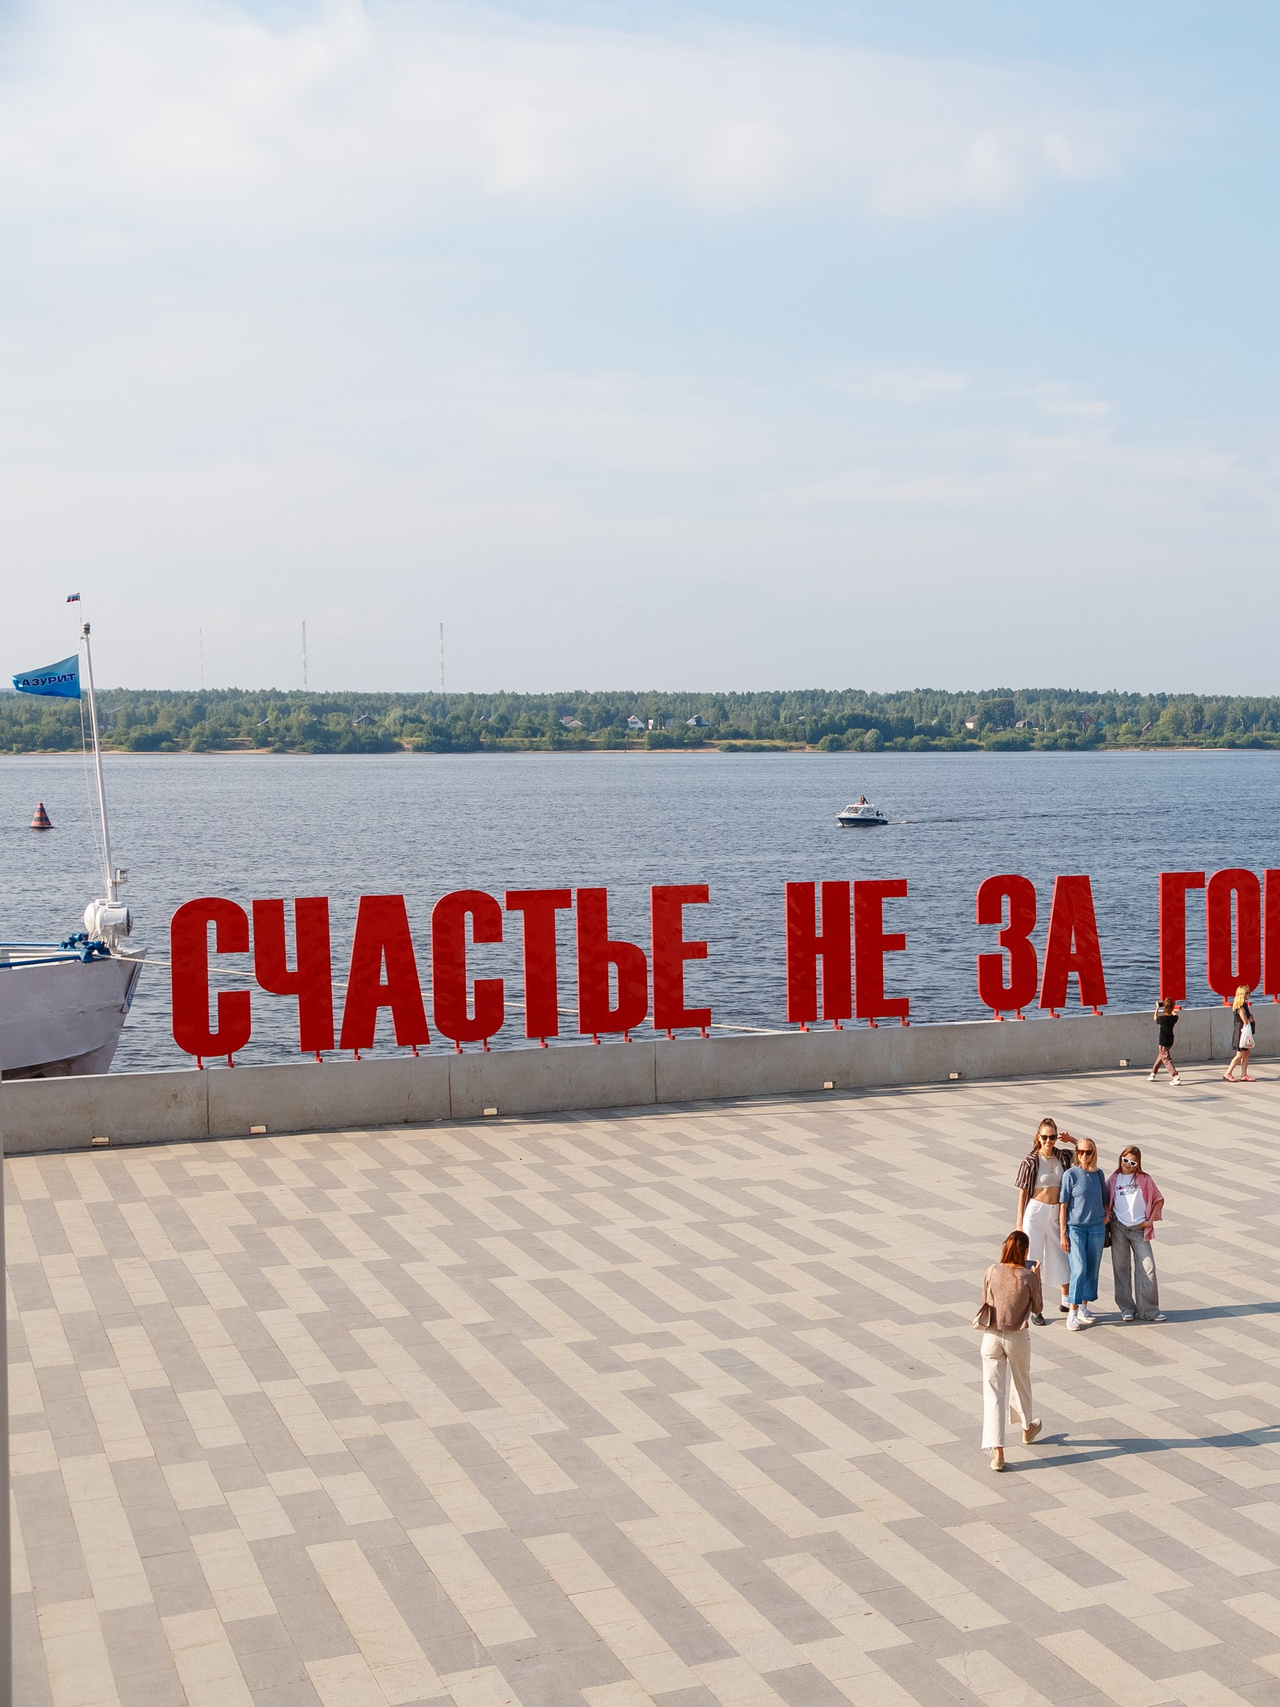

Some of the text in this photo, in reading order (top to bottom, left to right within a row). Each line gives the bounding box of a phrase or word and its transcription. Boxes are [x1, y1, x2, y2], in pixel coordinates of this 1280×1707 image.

[16, 673, 76, 687] АЗУРИТ
[170, 885, 712, 1057] СЧАСТЬЕ
[785, 879, 910, 1022] НЕ
[977, 874, 1108, 1010] ЗА
